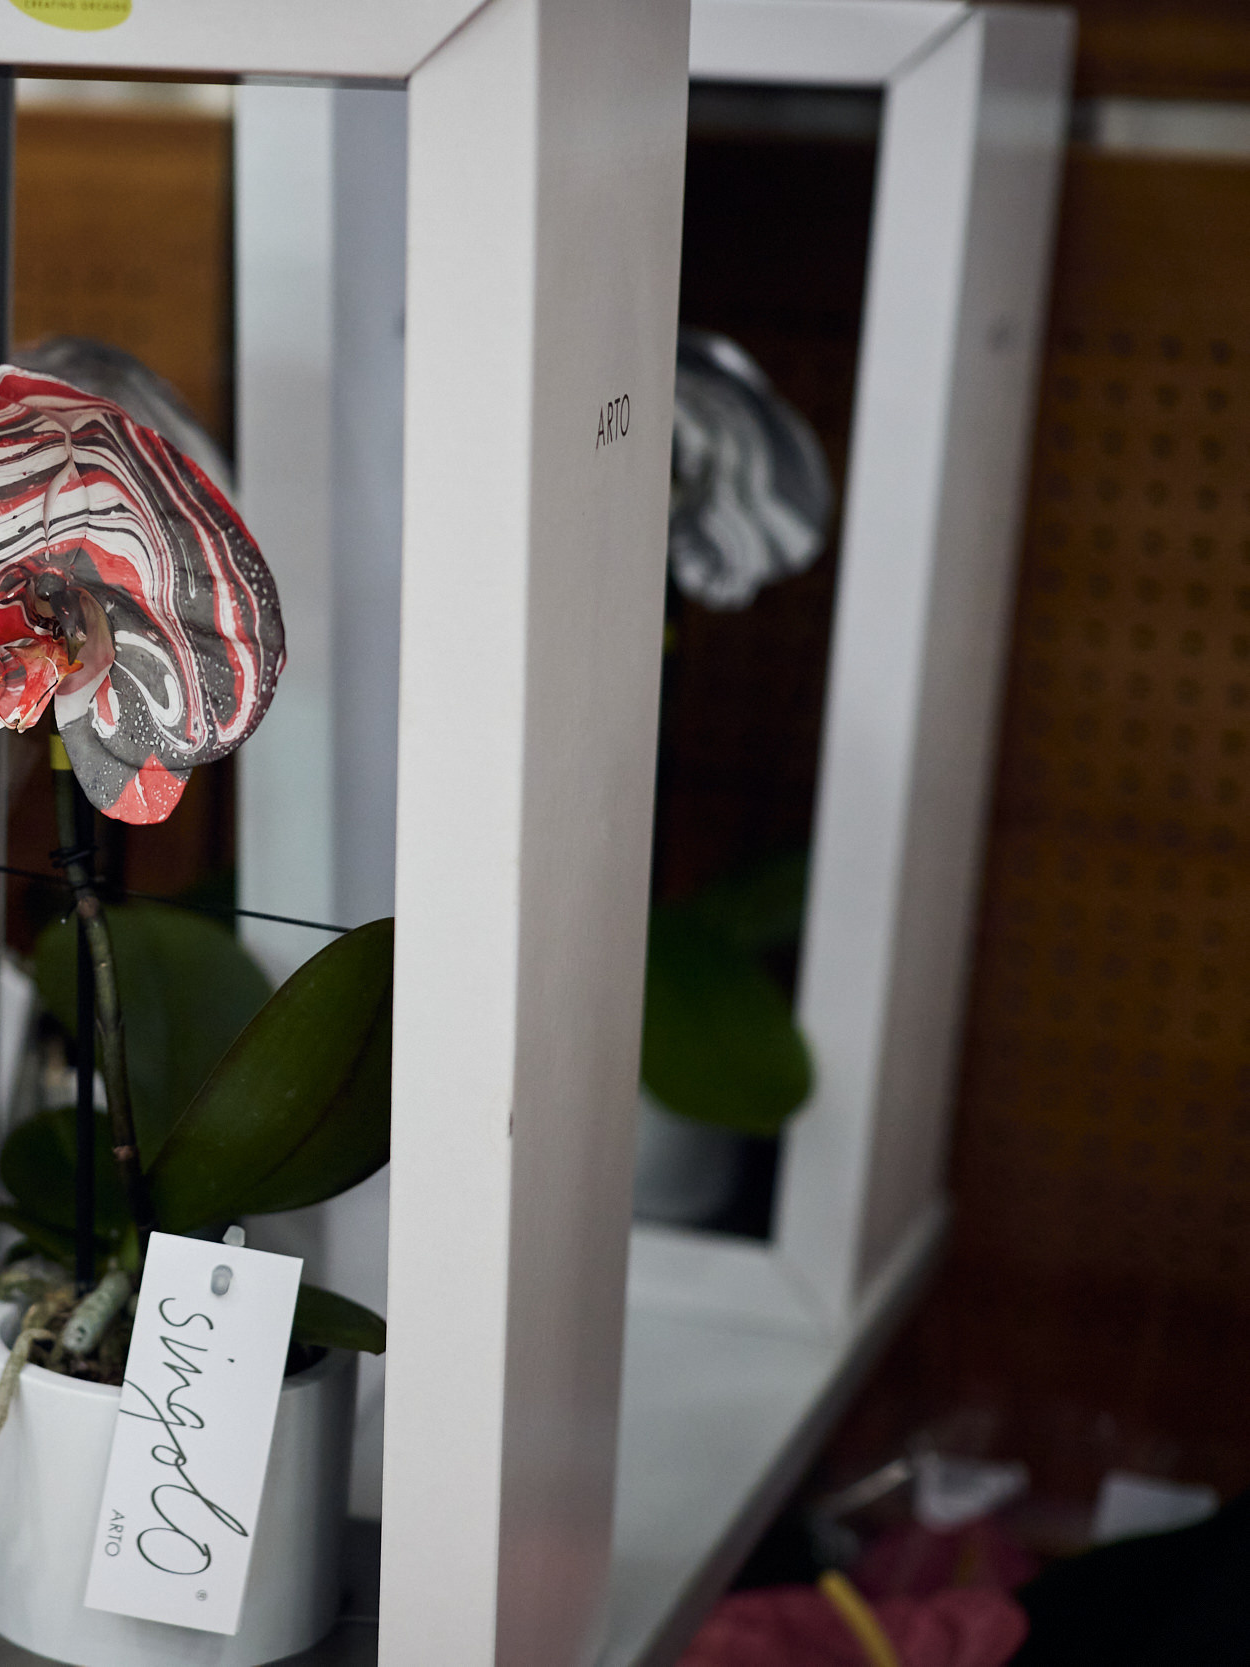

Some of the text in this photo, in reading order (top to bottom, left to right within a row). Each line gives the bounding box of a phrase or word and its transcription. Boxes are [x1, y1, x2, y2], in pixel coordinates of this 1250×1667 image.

[595, 393, 630, 450] ARTO
[119, 1297, 249, 1575] singolo
[104, 1508, 125, 1557] ARTO
